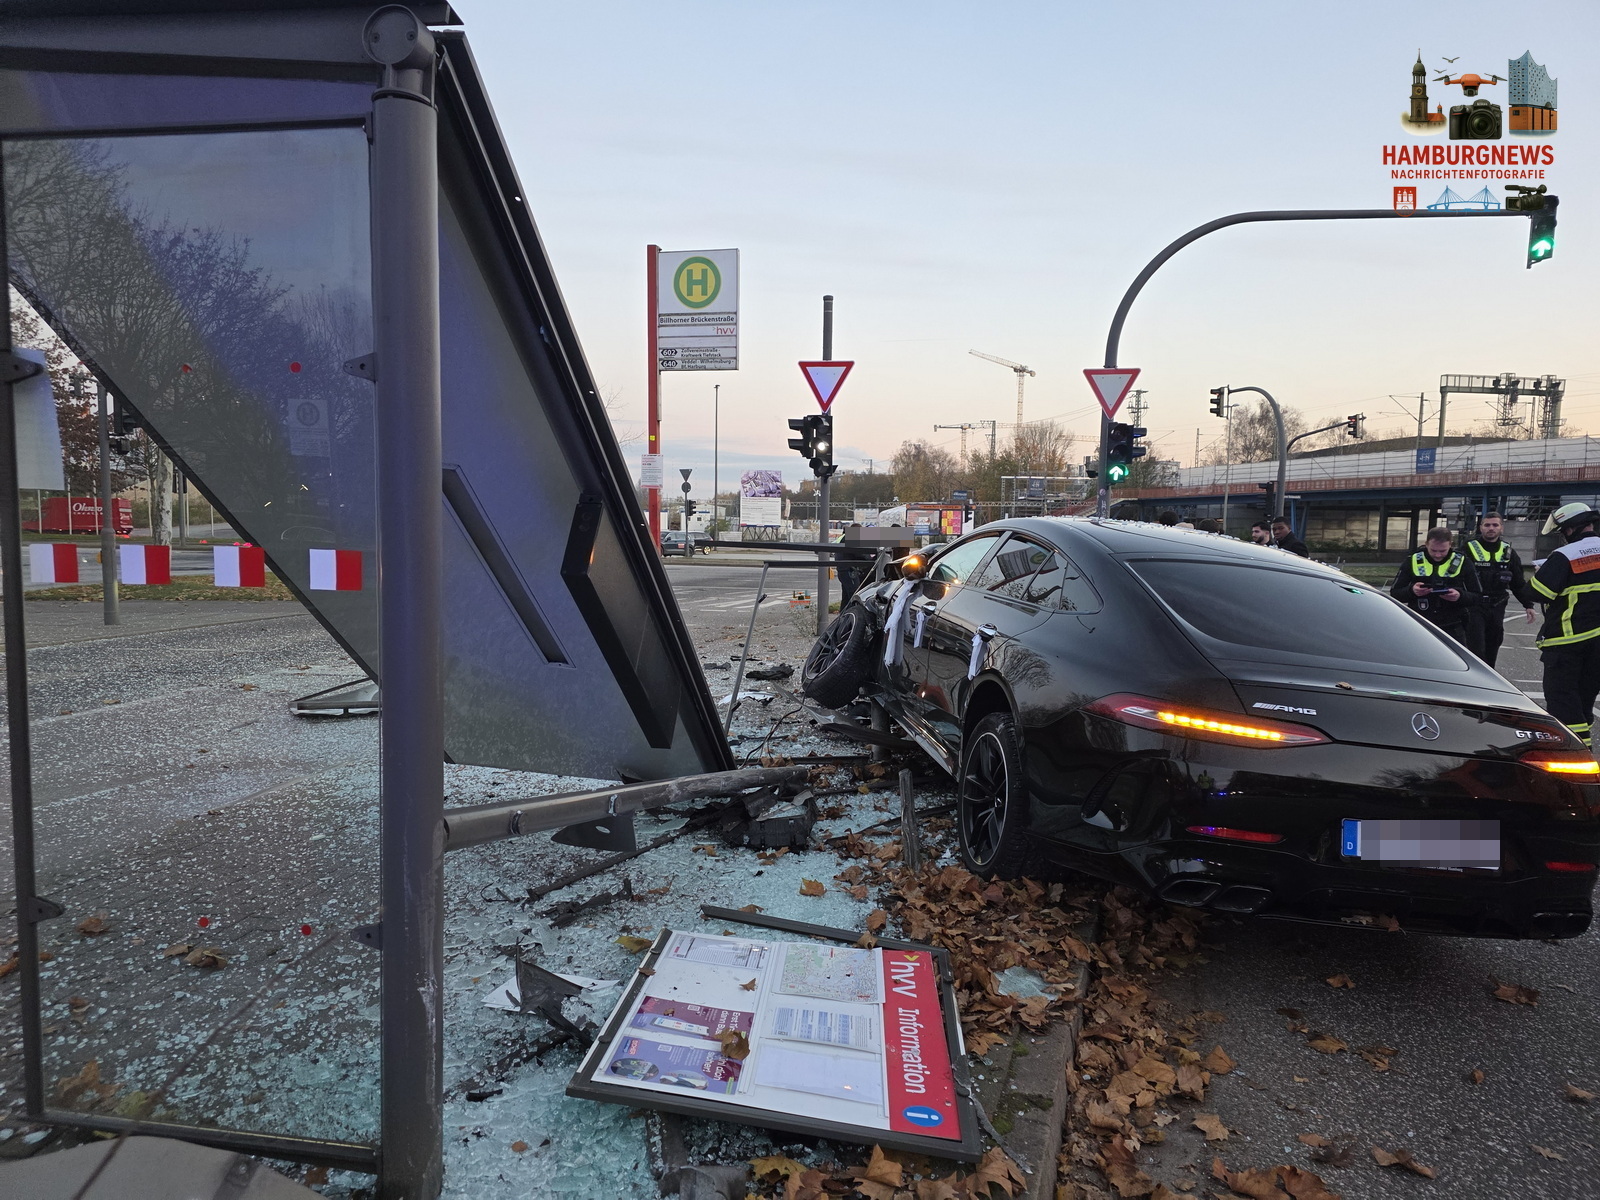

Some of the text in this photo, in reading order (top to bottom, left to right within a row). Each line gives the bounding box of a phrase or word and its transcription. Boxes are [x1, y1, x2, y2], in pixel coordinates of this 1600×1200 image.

[687, 269, 708, 296] H
[690, 315, 735, 323] Brückenstraße
[716, 326, 735, 335] hvv
[663, 360, 676, 368] 640
[1273, 705, 1317, 716] AMG
[1515, 730, 1532, 739] GT
[1535, 731, 1553, 740] 63
[1347, 841, 1353, 850] D
[889, 961, 920, 998] hvv
[898, 1007, 931, 1095] Information
